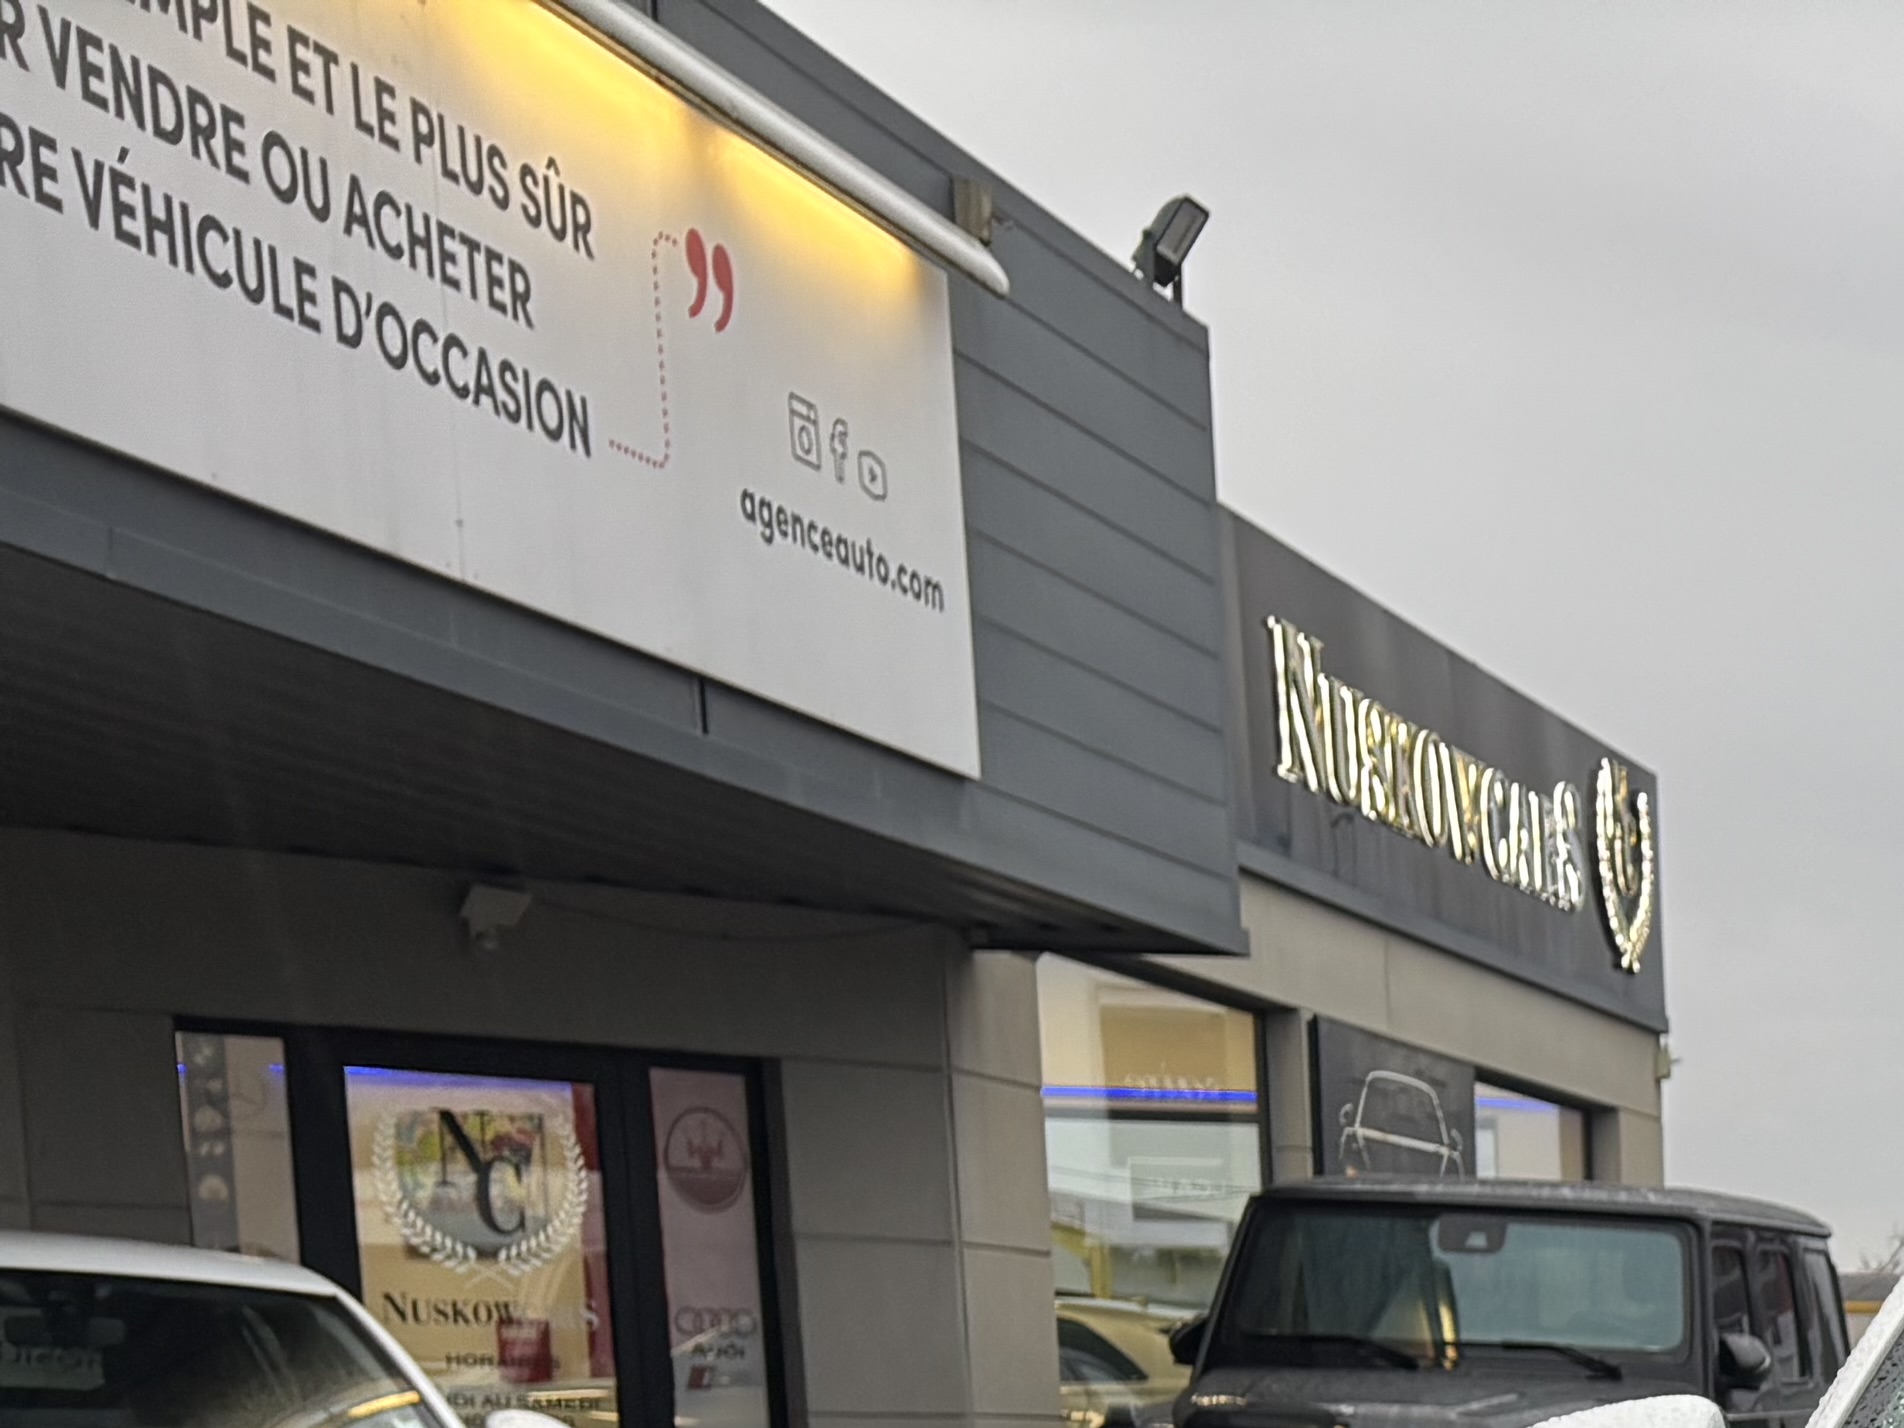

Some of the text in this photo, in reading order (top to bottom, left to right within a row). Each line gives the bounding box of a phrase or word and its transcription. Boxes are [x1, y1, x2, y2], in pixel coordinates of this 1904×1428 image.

[37, 3, 250, 184] VENDRE
[261, 130, 331, 223] OU
[343, 173, 534, 330] ACHETER
[287, 24, 339, 116] ET
[350, 62, 400, 152] LE
[410, 96, 510, 211] PLUS
[519, 156, 594, 260] SÛR
[71, 146, 321, 334] VÉHICULE
[332, 275, 591, 459] D'OCCASION
[740, 487, 946, 613] agenceauto.com
